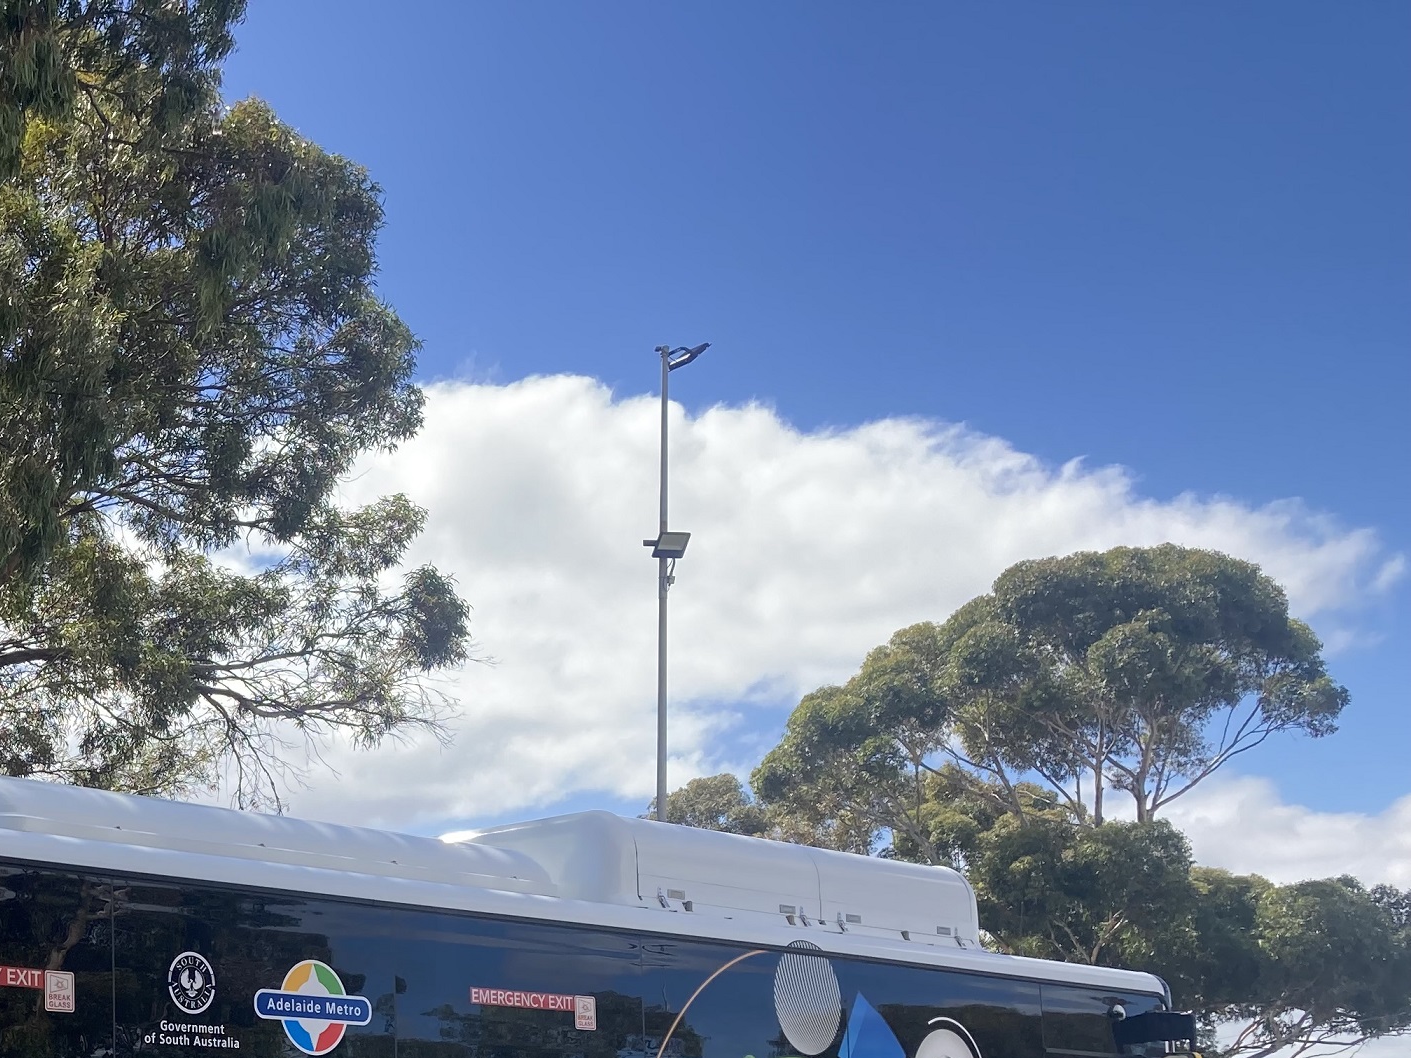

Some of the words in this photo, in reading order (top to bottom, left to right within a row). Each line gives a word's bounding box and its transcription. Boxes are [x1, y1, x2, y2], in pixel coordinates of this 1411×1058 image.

[176, 956, 207, 973] SOUTH
[6, 968, 41, 987] EXIT
[48, 993, 71, 1001] BREAK
[48, 1001, 71, 1009] GLASS
[471, 988, 545, 1008] EMERGENCY
[548, 995, 573, 1010] EXIT
[267, 997, 322, 1014] Adelaide
[325, 1001, 362, 1017] Metro
[160, 1020, 225, 1035] Government
[144, 1032, 156, 1044] of
[159, 1033, 190, 1046] South
[194, 1035, 240, 1049] Australia
